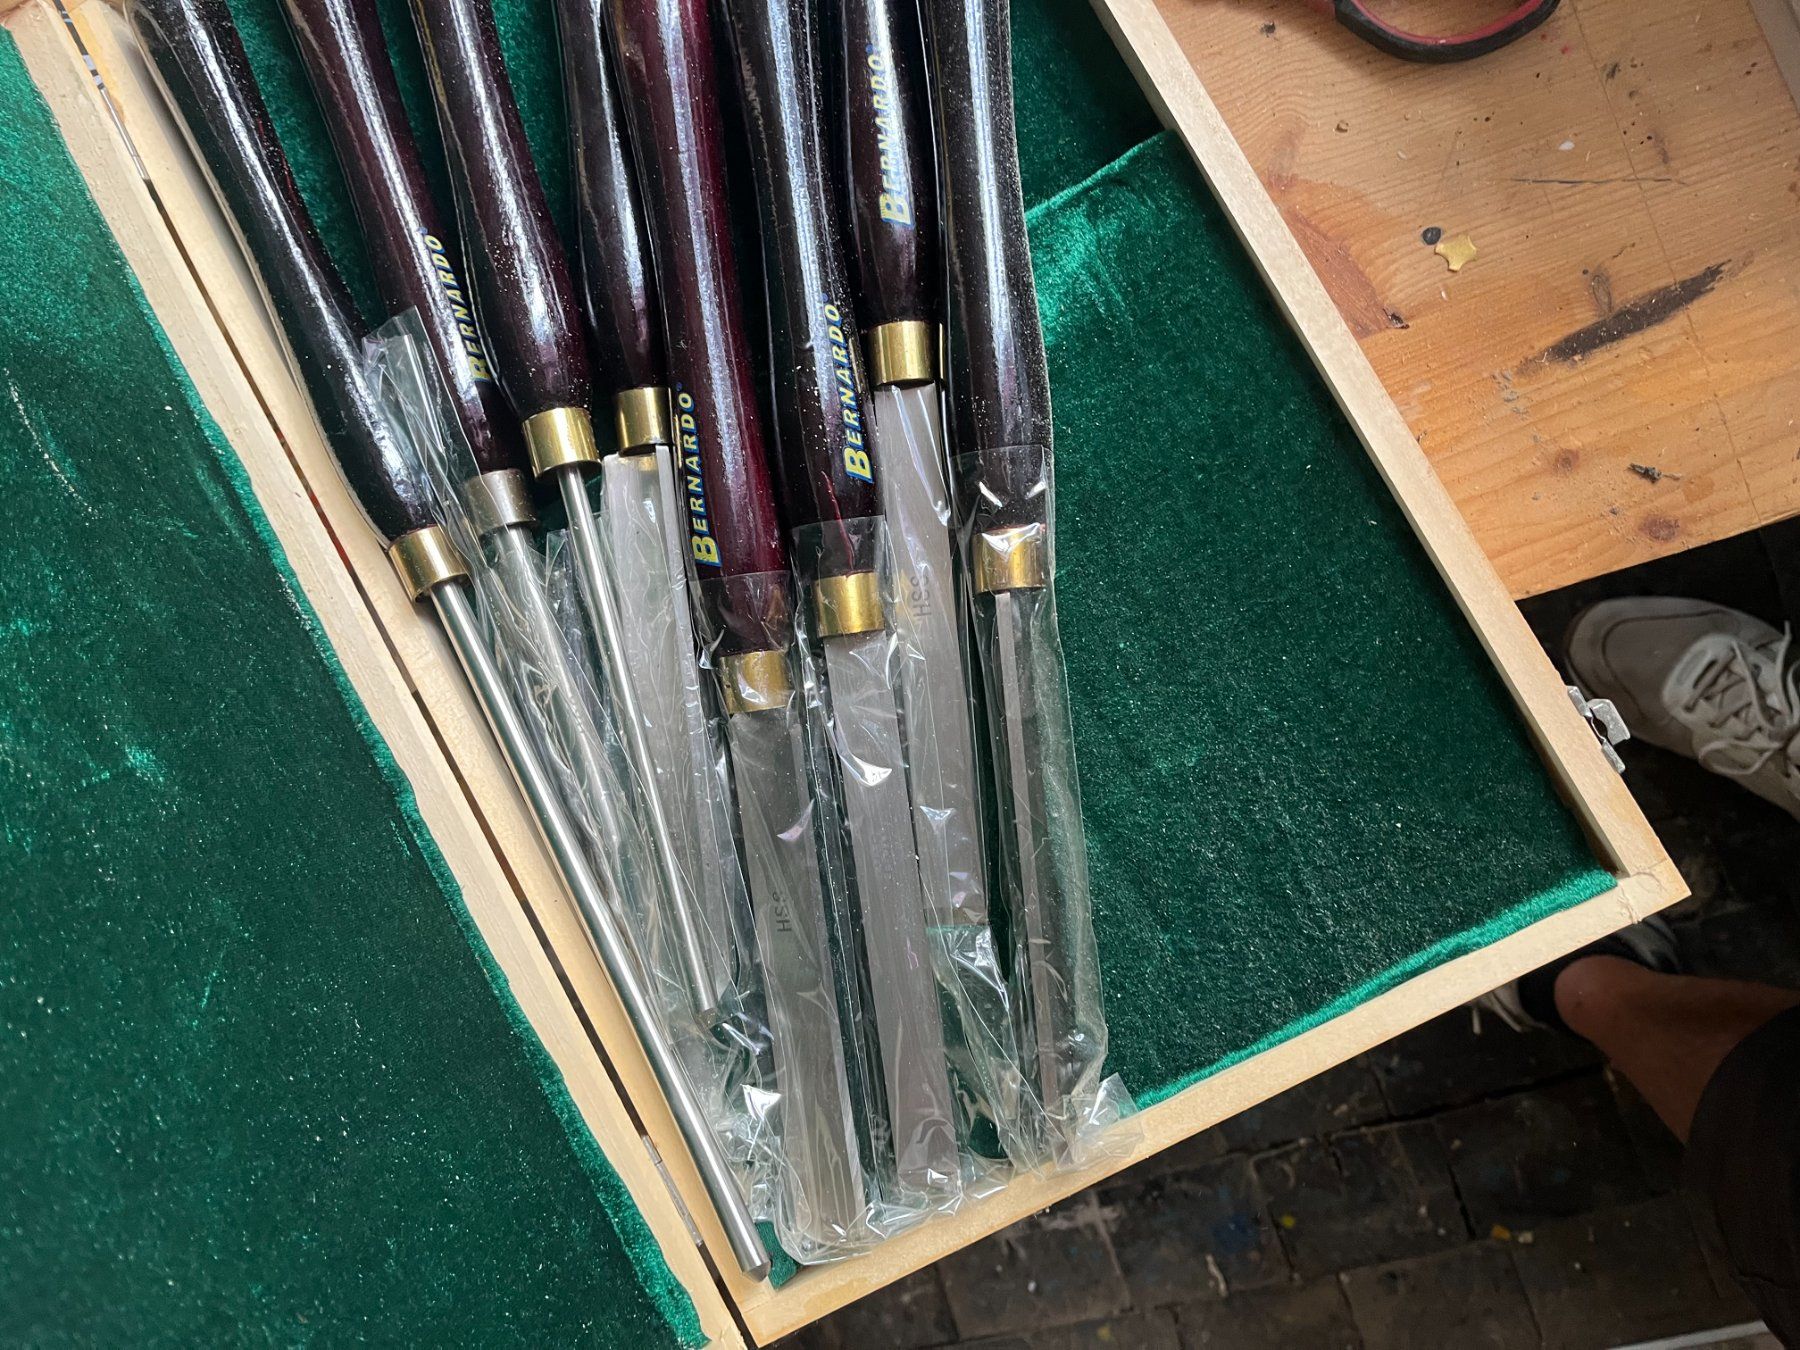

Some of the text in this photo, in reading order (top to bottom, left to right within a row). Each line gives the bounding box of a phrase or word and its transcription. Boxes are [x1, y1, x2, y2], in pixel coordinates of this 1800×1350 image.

[867, 53, 914, 227] BERNARDO
[424, 234, 491, 382] BERNARDO
[824, 303, 874, 483] BERNARDO
[678, 392, 722, 568] BERNARDO
[910, 575, 932, 617] HSS
